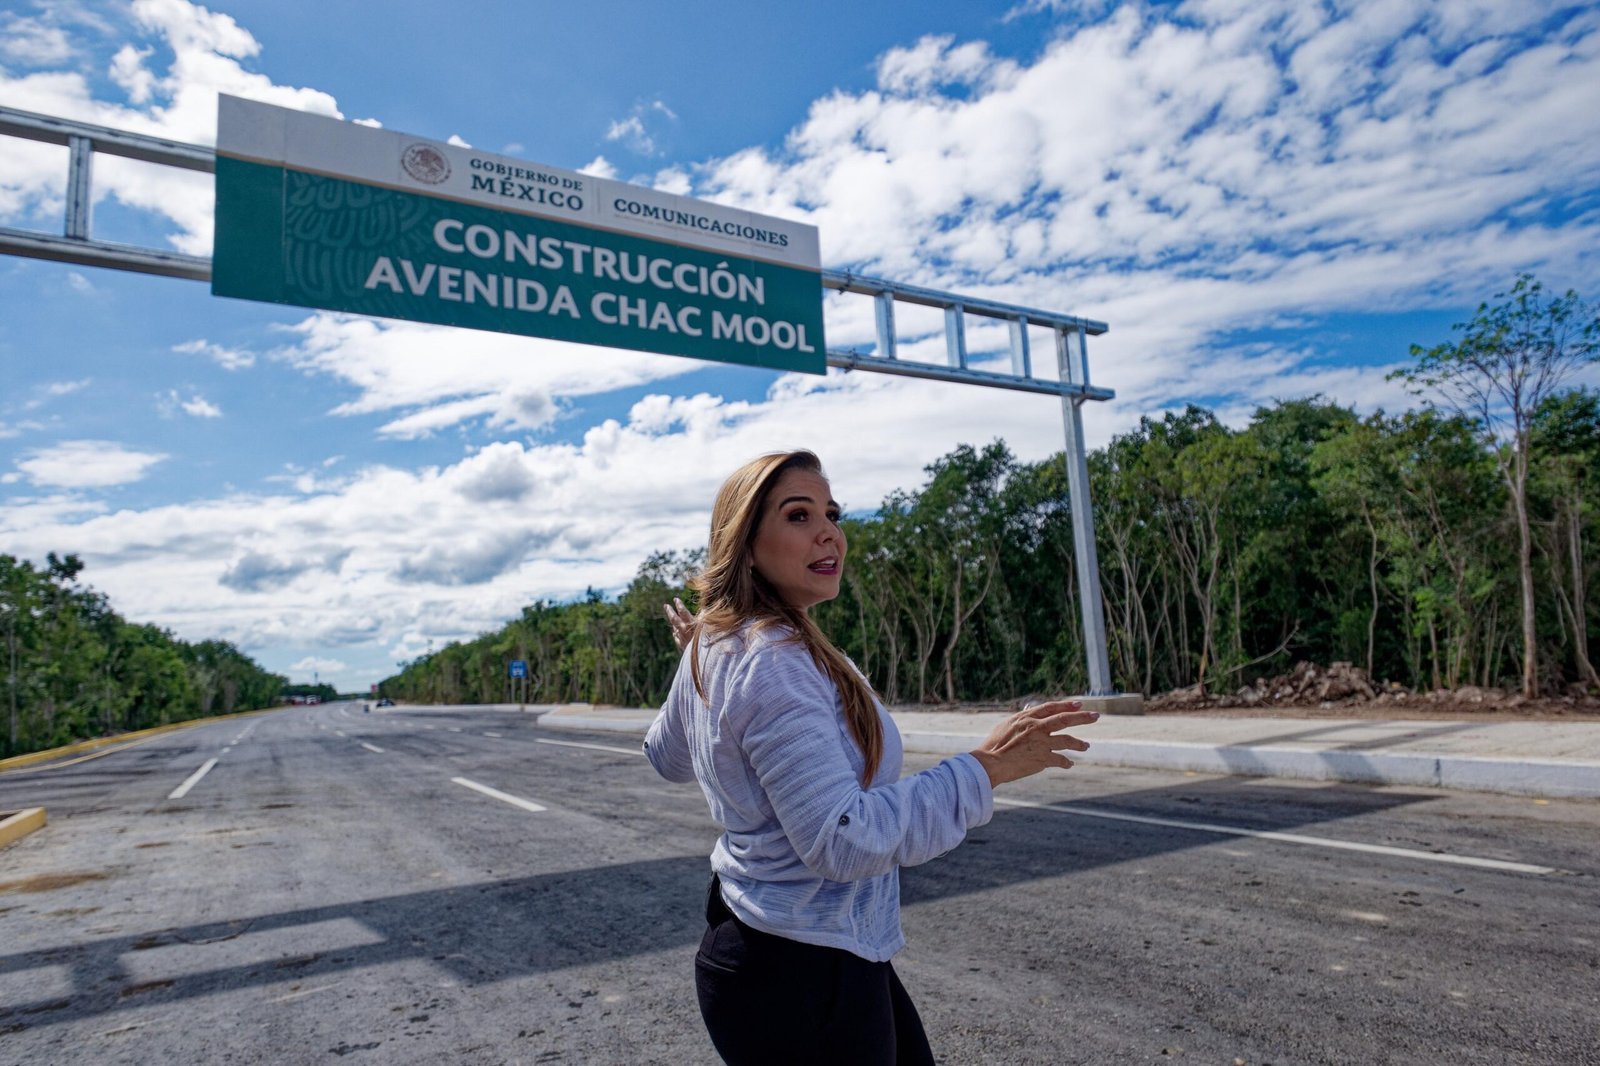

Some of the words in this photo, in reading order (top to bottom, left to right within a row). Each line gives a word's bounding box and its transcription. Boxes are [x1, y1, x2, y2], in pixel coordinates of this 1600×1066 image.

[470, 158, 559, 186] GOBIERNO
[562, 178, 584, 192] DE
[471, 173, 584, 211] MÉXICO
[614, 198, 788, 247] COMUNICACIONES
[433, 218, 765, 305] CONSTRUCCIÓN
[364, 256, 581, 319] AVENIDA
[590, 291, 702, 337] CHAC
[711, 310, 815, 353] MOOL
